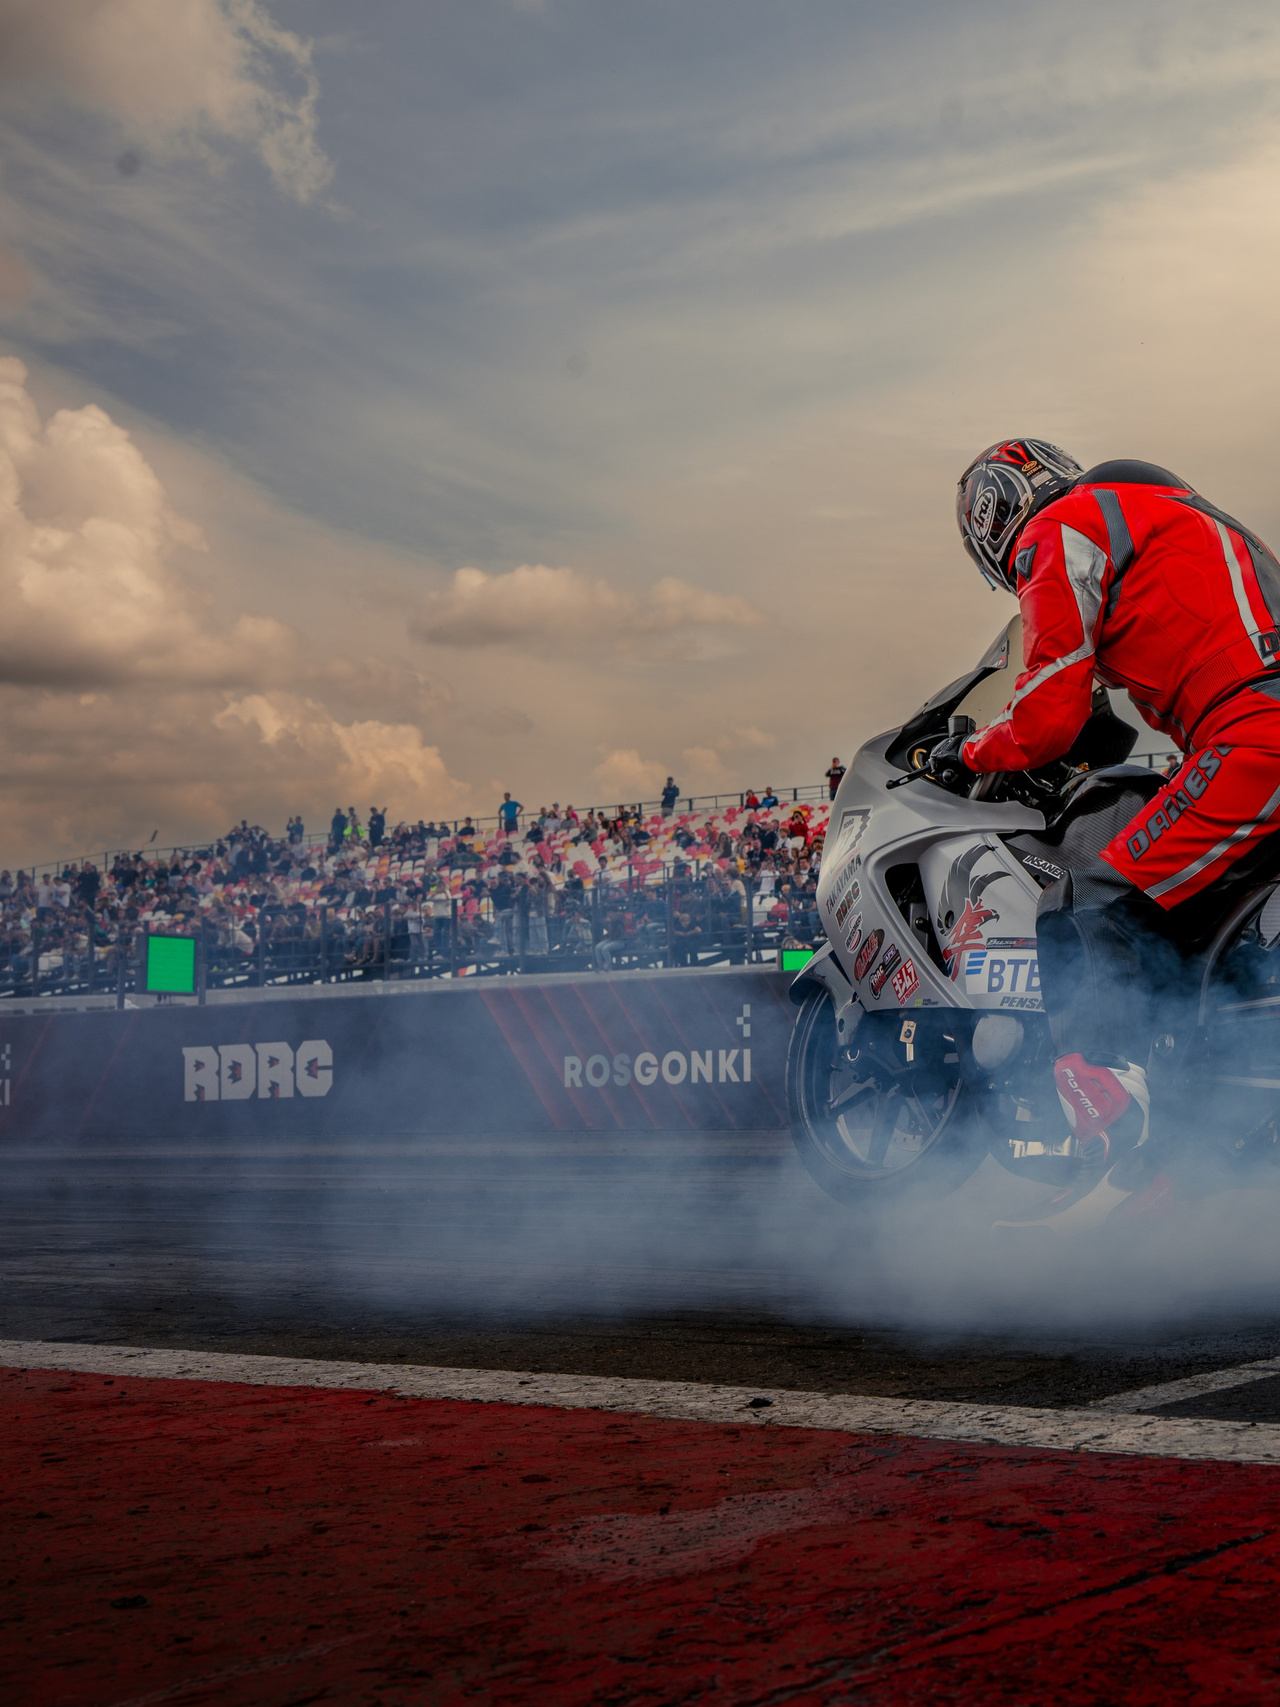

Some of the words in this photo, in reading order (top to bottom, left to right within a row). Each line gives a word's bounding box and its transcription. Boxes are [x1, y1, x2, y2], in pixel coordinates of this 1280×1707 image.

[974, 493, 991, 534] Arai
[826, 853, 862, 915] TAKAYAMA
[835, 880, 860, 928] RDRC
[893, 961, 916, 999] ヨシムラ
[182, 1039, 333, 1102] RDRC
[564, 1049, 751, 1088] ROSGONKI
